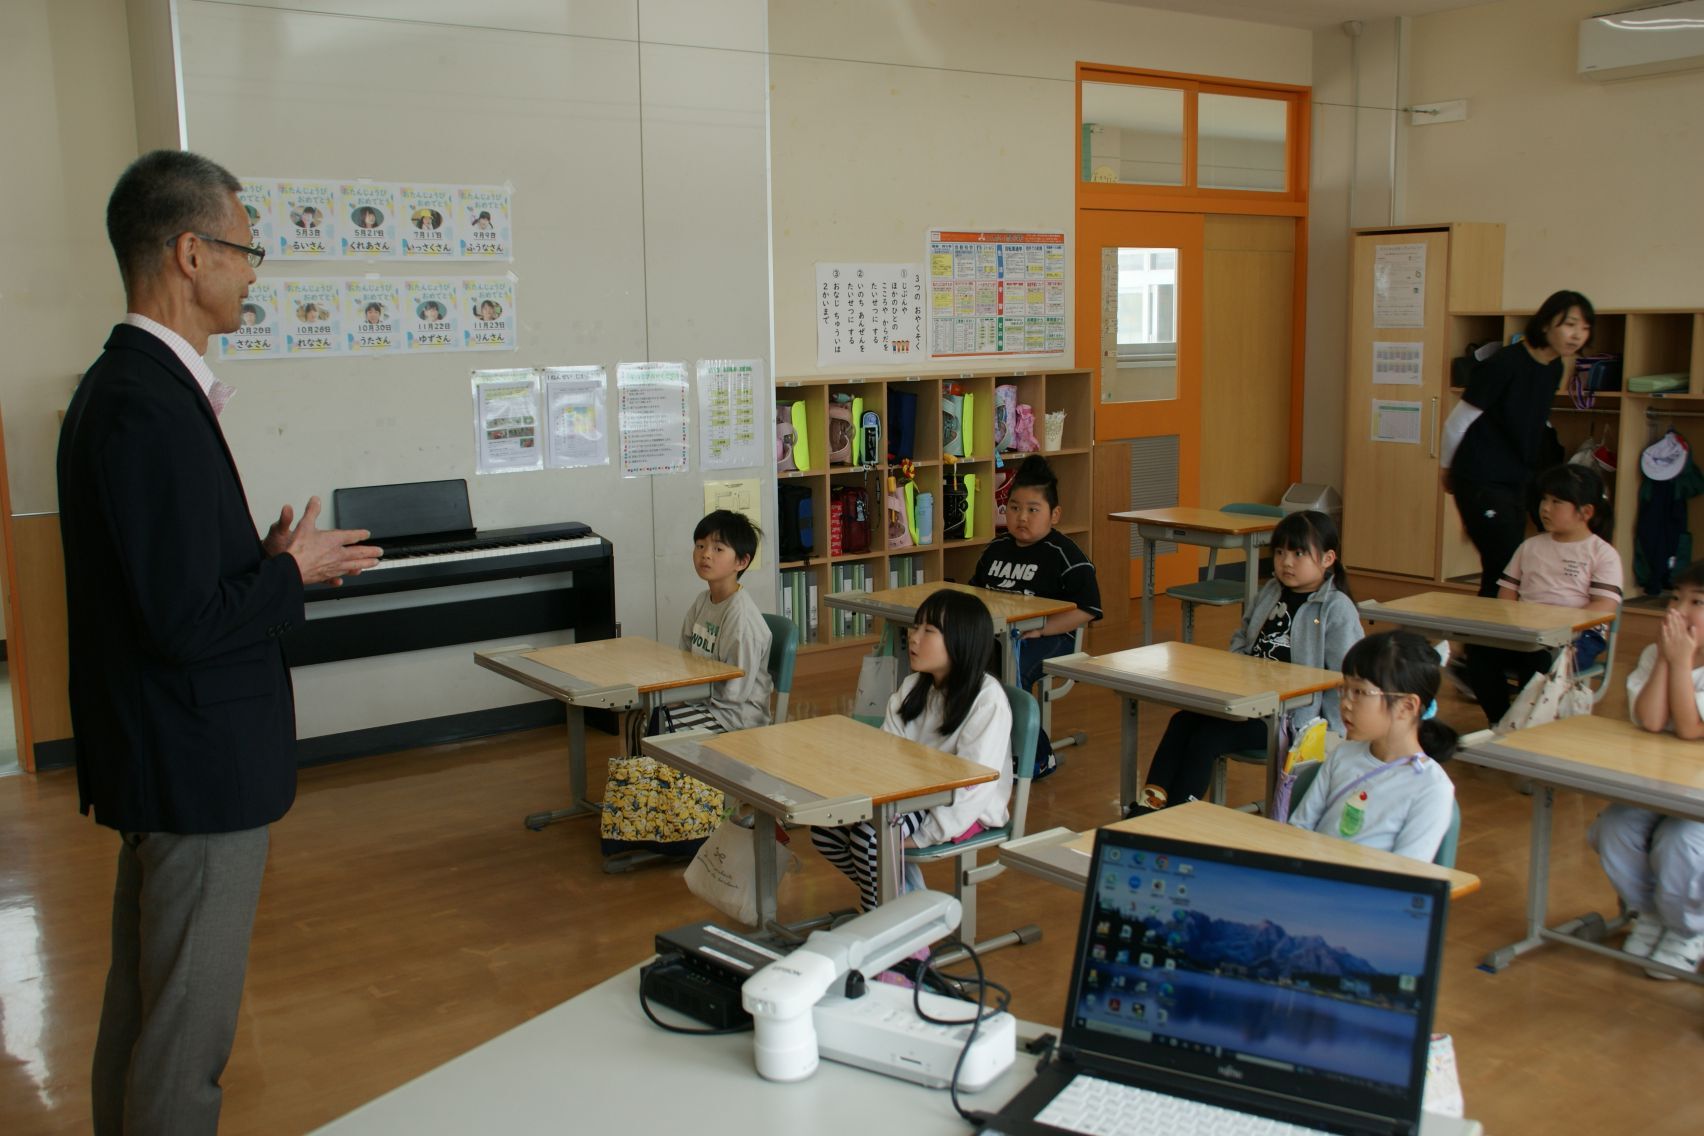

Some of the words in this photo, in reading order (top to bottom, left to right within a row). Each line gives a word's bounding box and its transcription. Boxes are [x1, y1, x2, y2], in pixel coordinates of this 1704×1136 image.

[355, 229, 384, 237] 5月21日
[414, 231, 442, 239] 7月11日
[473, 231, 496, 239] 9月9日
[292, 241, 325, 250] るいさん
[350, 241, 390, 250] くれあさん
[407, 243, 451, 252] いっさくさん
[466, 243, 504, 252] ふうなさん
[419, 334, 450, 343] ゆずさん
[475, 332, 504, 342] りんさん
[848, 328, 854, 345] する
[872, 328, 878, 344] する
[237, 339, 271, 349] さなさん
[298, 338, 331, 347] れなさん
[360, 336, 391, 346] うたさん
[988, 560, 1038, 580] HANG
